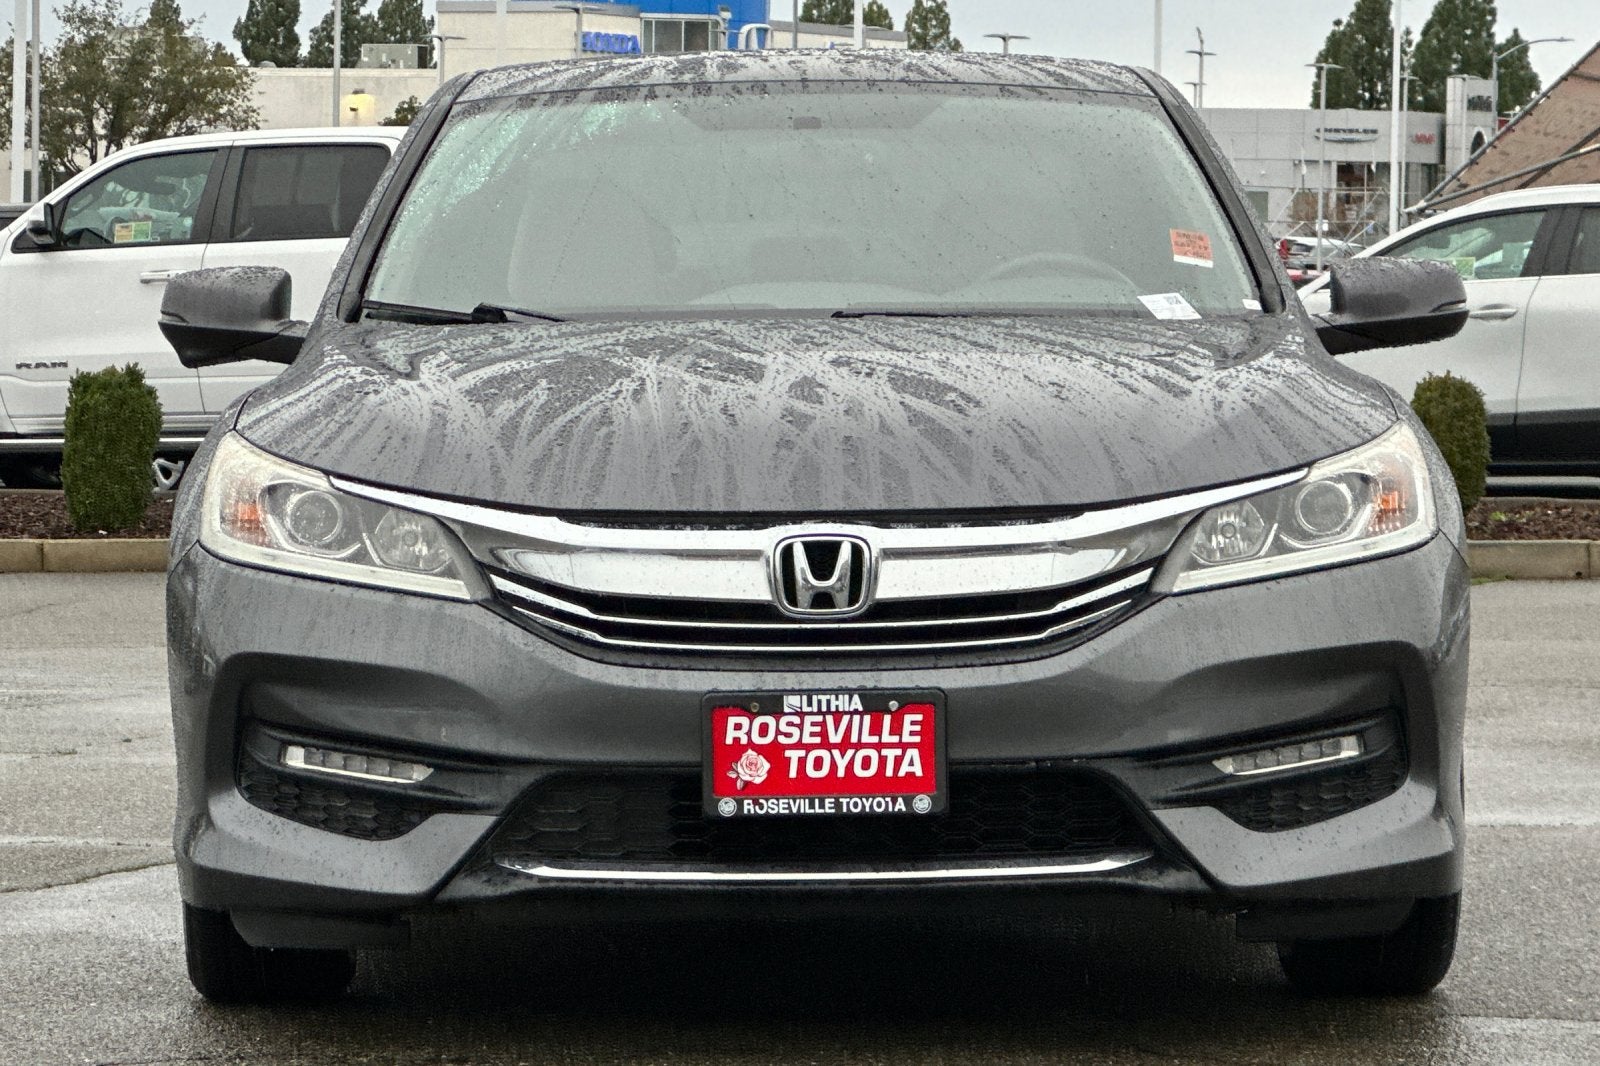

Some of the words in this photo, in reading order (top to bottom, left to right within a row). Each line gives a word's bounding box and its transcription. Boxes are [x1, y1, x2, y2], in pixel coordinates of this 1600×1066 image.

[15, 361, 69, 370] RAM
[801, 693, 864, 713] LITHIA
[725, 714, 923, 745] ROSEVILLE
[784, 748, 923, 778] TOYOTA
[743, 797, 836, 814] ROSEVILLE
[839, 797, 906, 812] TOYOTA
